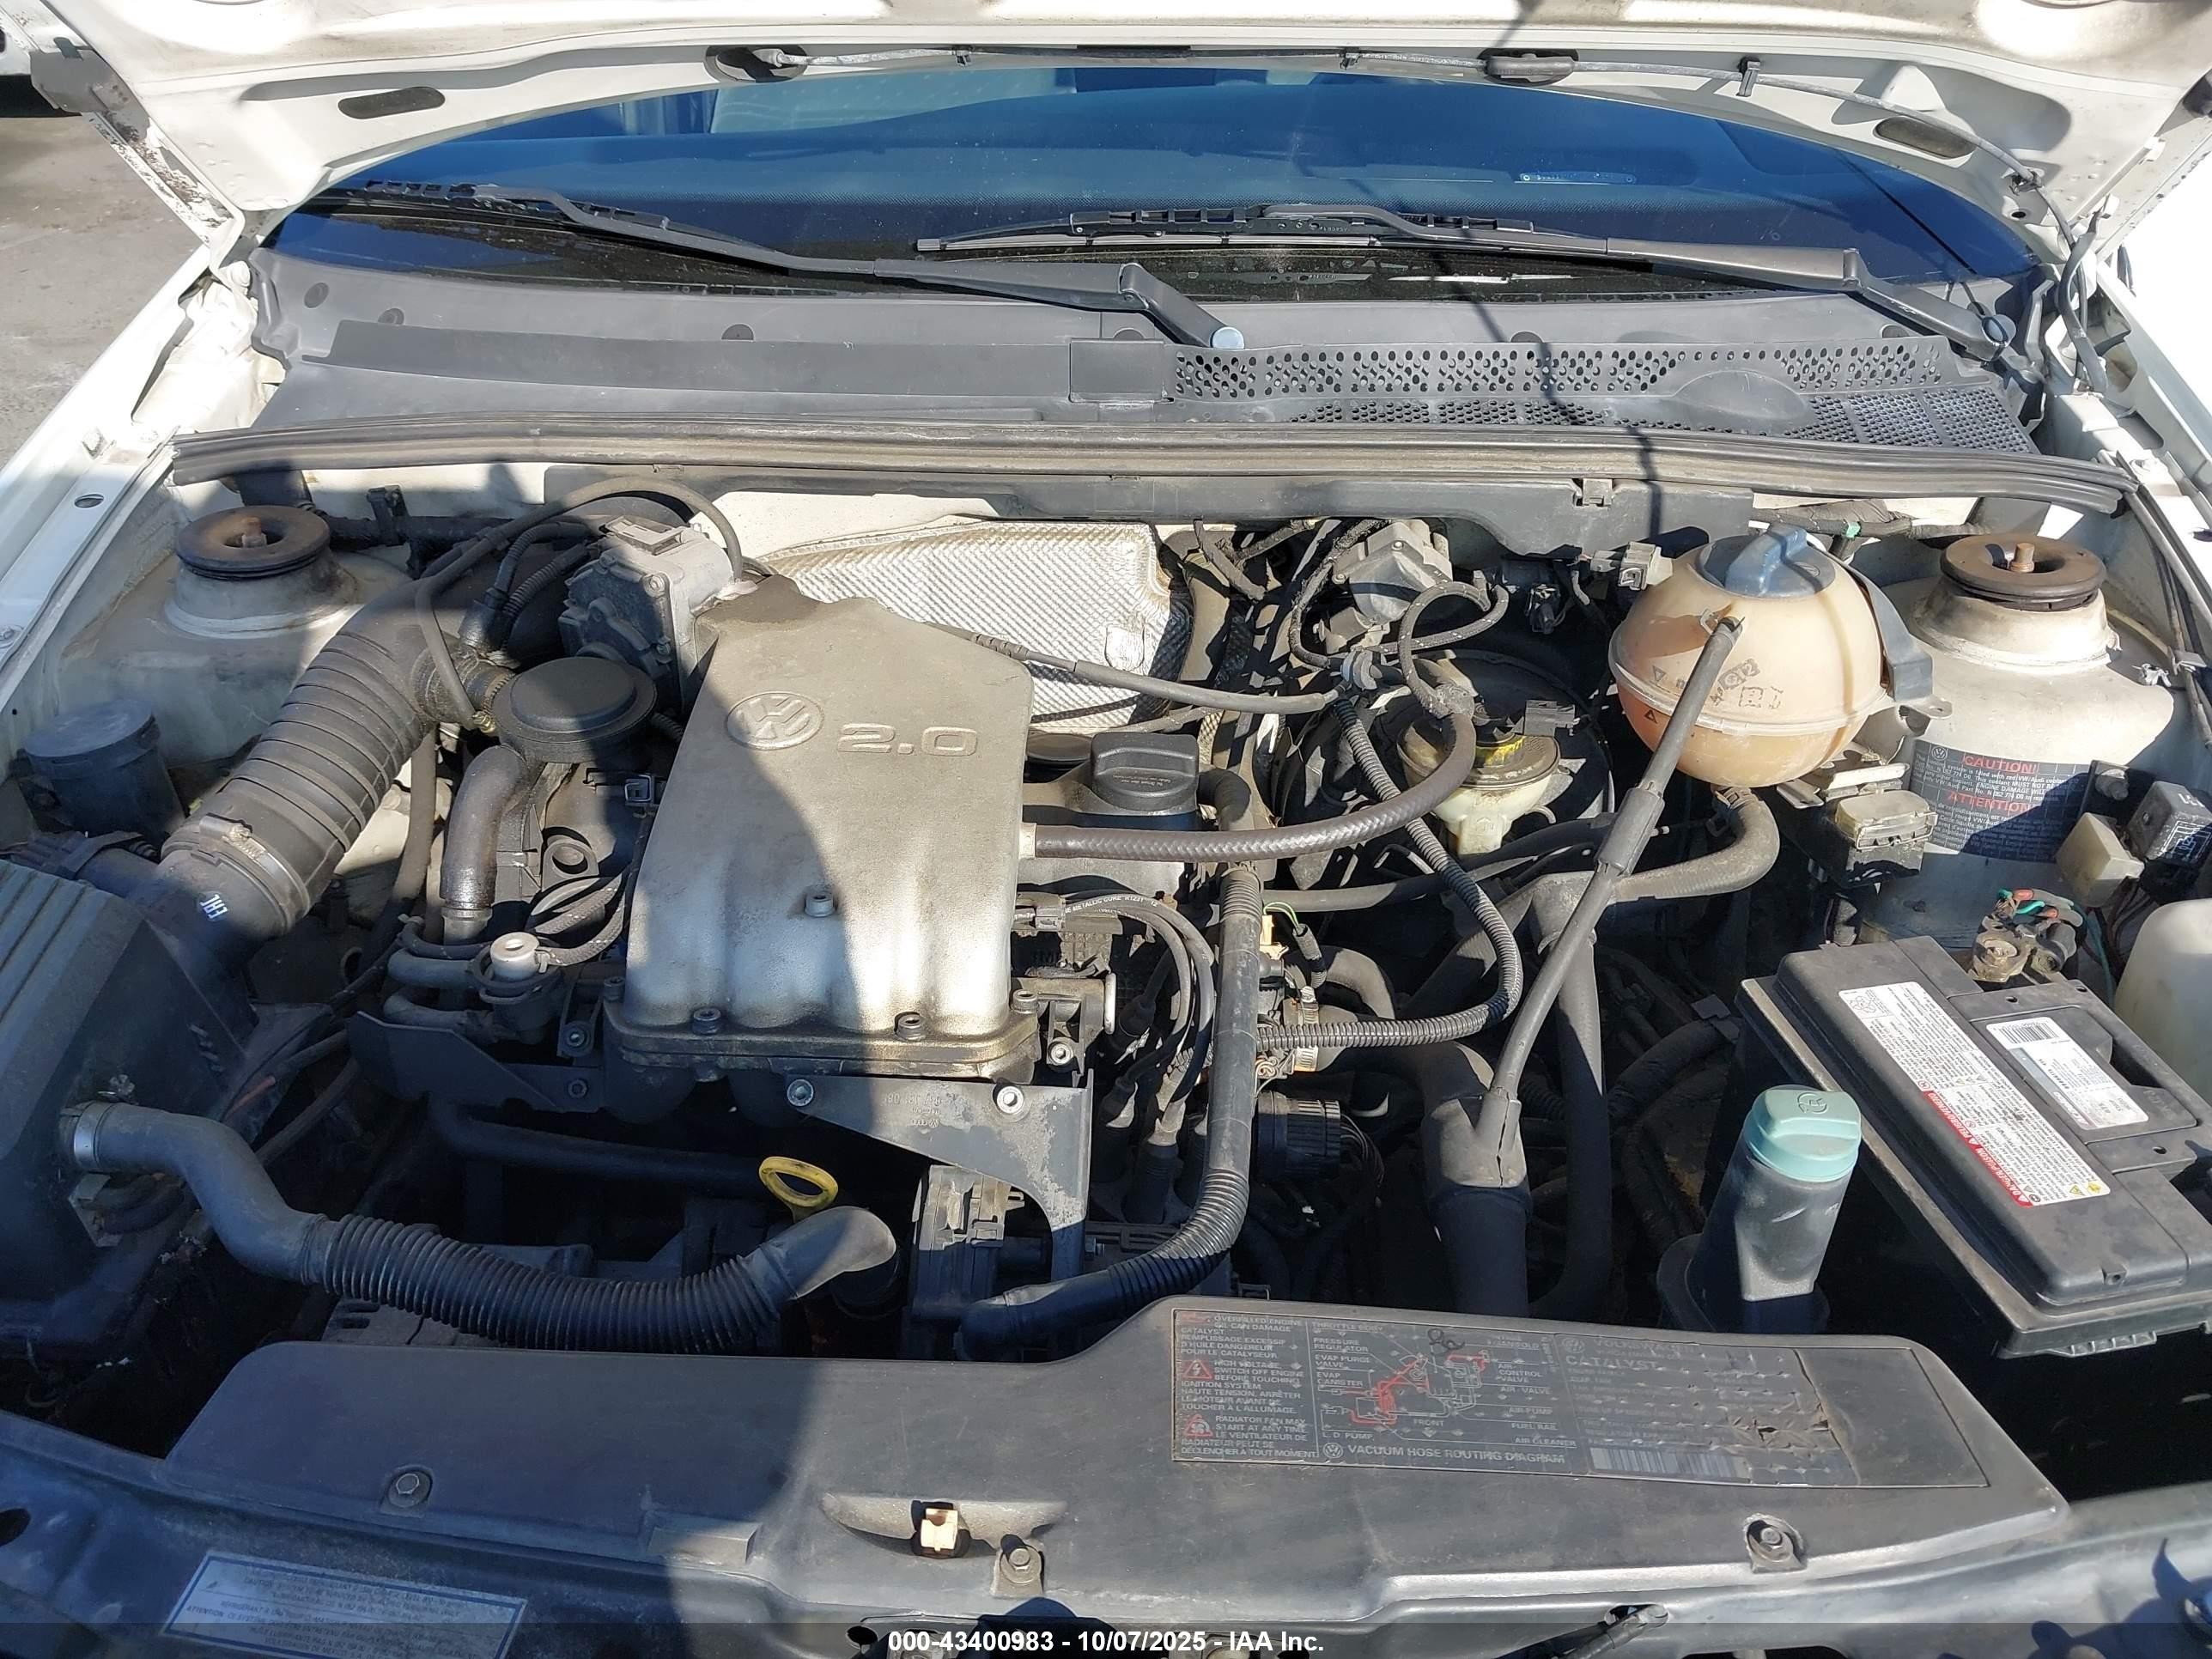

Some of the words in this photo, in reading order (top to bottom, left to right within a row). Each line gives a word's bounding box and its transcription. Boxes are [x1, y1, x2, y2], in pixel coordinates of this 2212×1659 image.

[837, 723, 979, 757] 2.0
[1965, 755, 2038, 774] CAUTION!
[1947, 764, 1966, 773] system
[2018, 774, 2044, 784] VW/Audi
[1975, 781, 2000, 791] ENGINE
[2001, 783, 2029, 794] DAMAGE
[2011, 780, 2029, 788] MUST
[1972, 1146, 2024, 1195] DANGER/POISON
[1214, 1315, 1267, 1325] OVERFILLED
[1311, 1322, 1357, 1331] THROTTLE
[1181, 1334, 1242, 1343] REMPLISSAGE
[1220, 1350, 1277, 1358] CATALYSEUR
[1565, 1355, 1659, 1370] CATALYST
[1214, 1366, 1250, 1375] SWITCH
[1317, 1378, 1364, 1387] CANISTER
[1413, 1419, 1443, 1427] FRONT
[1230, 1432, 1292, 1441] VENTILATEUR
[1533, 1437, 1577, 1446] CLEANER
[1348, 1444, 1404, 1456] VACUUM
[1407, 1447, 1441, 1458] HOSE
[1444, 1449, 1502, 1461] ROUTING
[1503, 1451, 1565, 1464] DIAGRAM
[186, 1605, 224, 1618] ATTENTION
